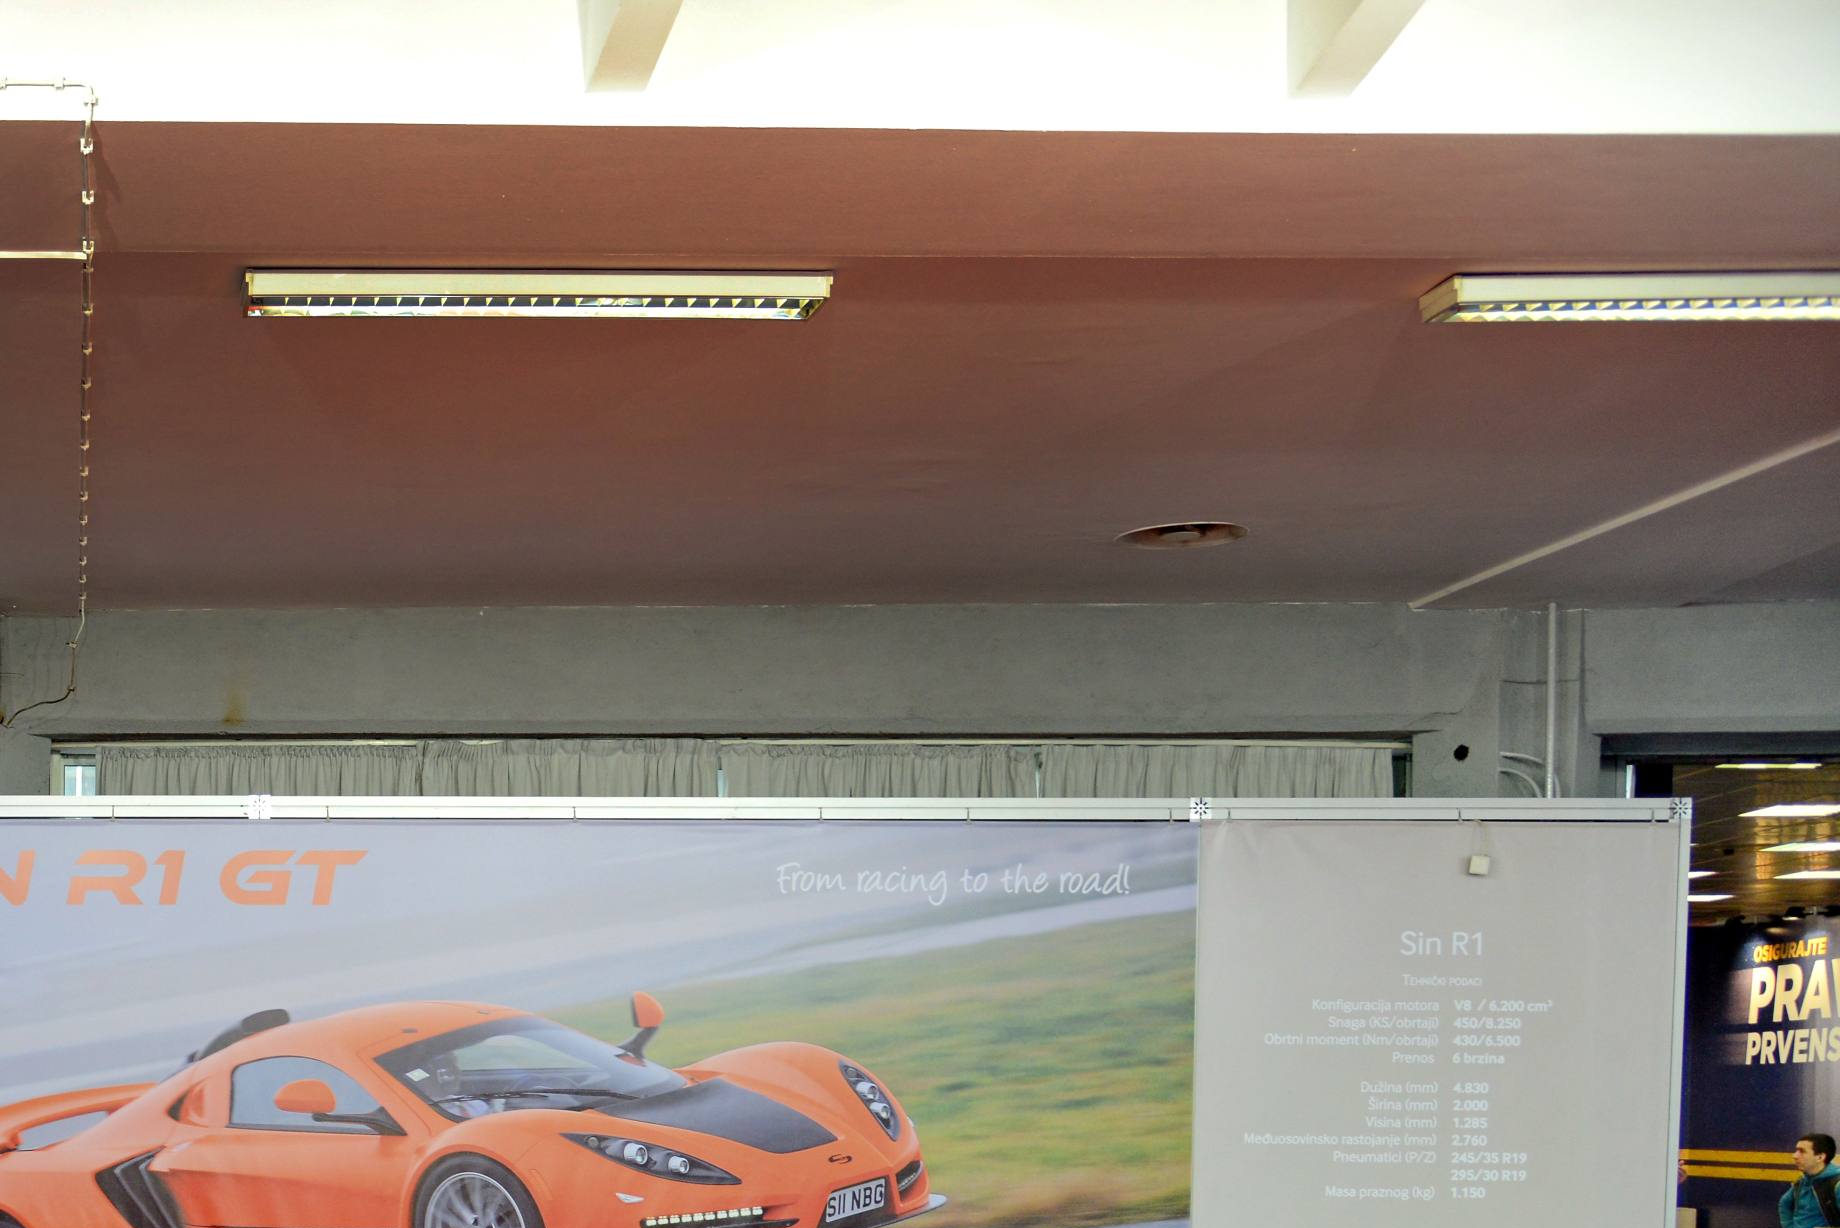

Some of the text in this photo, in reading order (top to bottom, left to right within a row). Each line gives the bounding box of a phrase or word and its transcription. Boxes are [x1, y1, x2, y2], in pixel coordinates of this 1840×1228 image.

[66, 849, 186, 905] R1
[218, 849, 369, 905] GT
[776, 861, 1132, 906] From racing to the road!
[1400, 930, 1484, 956] Sin R1
[1753, 937, 1828, 963] OSIGURAJTE
[1312, 999, 1525, 1014] Konfiguracija motora V8 6.200
[1328, 1016, 1521, 1031] Snaga (KS/obrtaji) 450/8.250
[1264, 1033, 1521, 1048] Obrtni moment (Nm/obrtaji) 430/6.500
[1745, 1026, 1840, 1066] PRVENS
[1392, 1051, 1505, 1065] Prenos 6 brzina
[1360, 1080, 1489, 1095] Dužina (mm) 4.830
[1367, 1096, 1489, 1112] Širina (mm) 2.000
[1365, 1115, 1488, 1130] Visina (mm) 1.285
[1244, 1132, 1488, 1148] Međuosovinsko rastojanje (mm) 2.760
[1333, 1150, 1528, 1165] Pneumatici (P/Z) 245/35 R19
[1450, 1169, 1528, 1182] 295/30 R19
[851, 1183, 884, 1211] NBG
[1325, 1185, 1486, 1201] Masa praznog (kg) 1.150
